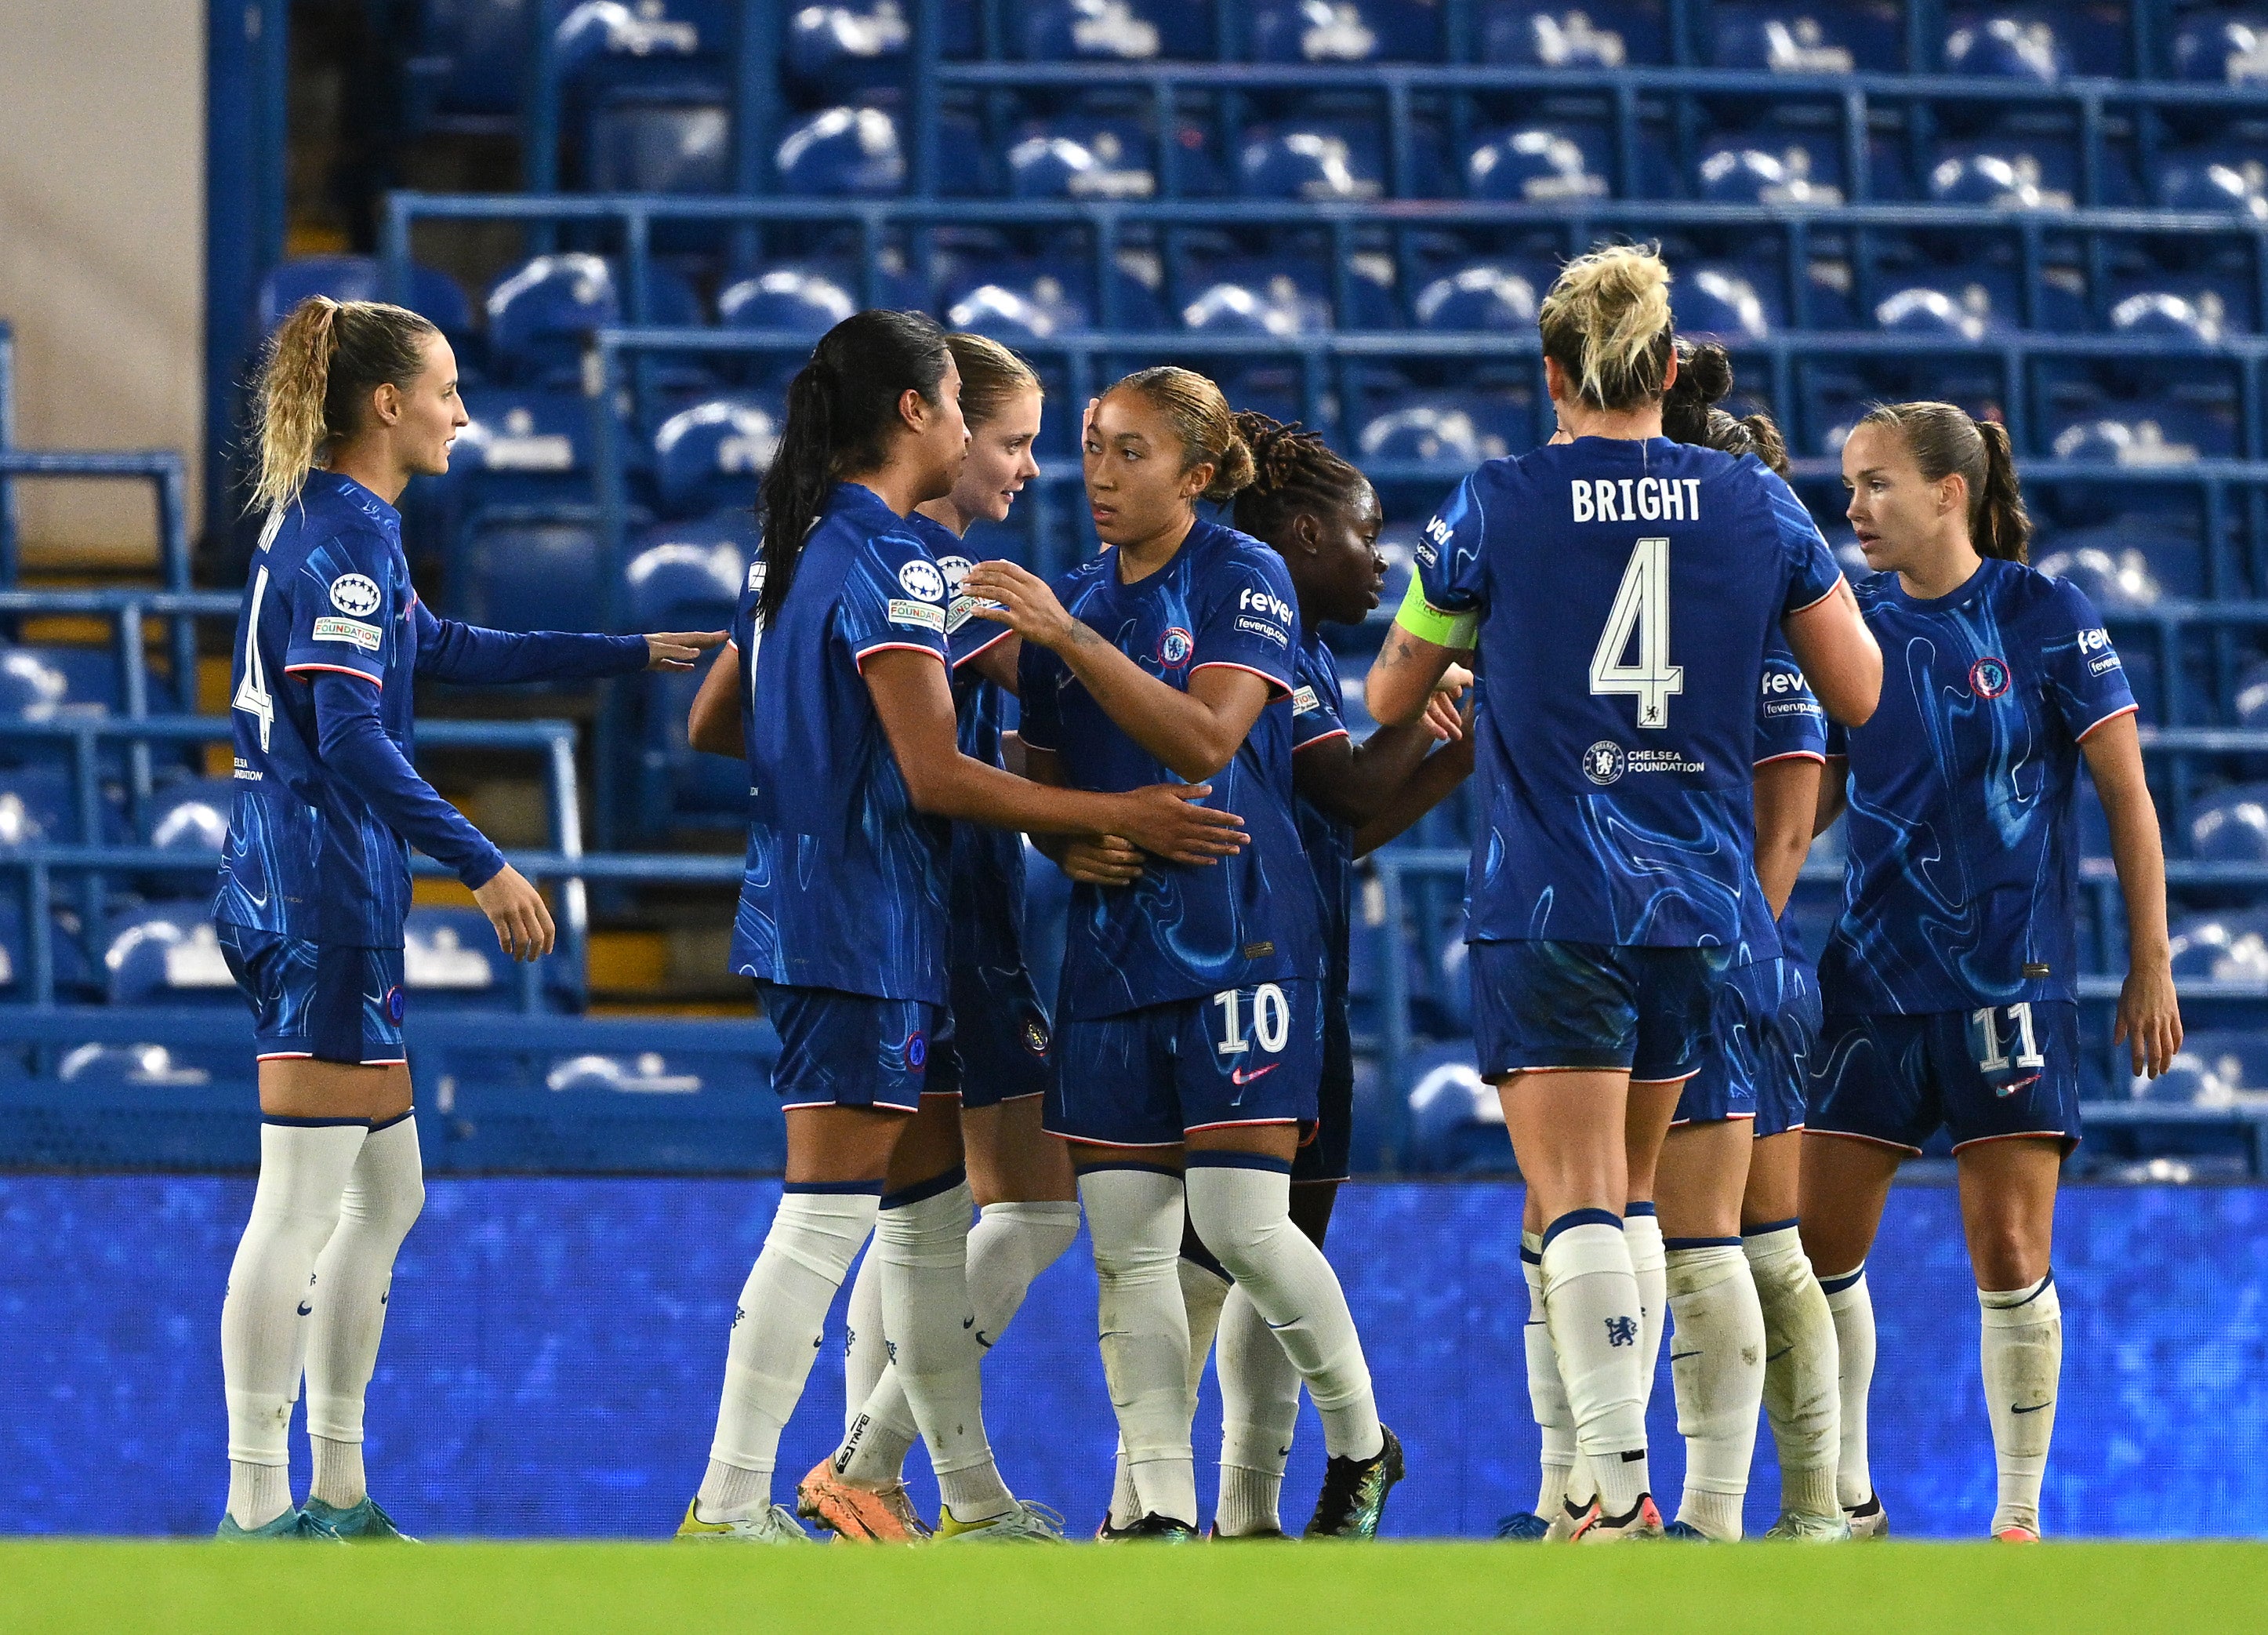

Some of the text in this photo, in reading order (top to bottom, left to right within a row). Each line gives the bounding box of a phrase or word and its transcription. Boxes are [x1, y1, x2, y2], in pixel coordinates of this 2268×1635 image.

[1571, 478, 1700, 522] BRIGHT
[1426, 514, 1453, 545] ver
[1239, 588, 1294, 627] fever
[1589, 537, 1683, 728] 4
[2078, 627, 2112, 655] fev
[232, 565, 274, 754] 4
[1628, 750, 1682, 761] CHELSEA
[1628, 761, 1705, 772] FOUNDATION
[1214, 983, 1290, 1054] 10
[1972, 1002, 2045, 1073] 11
